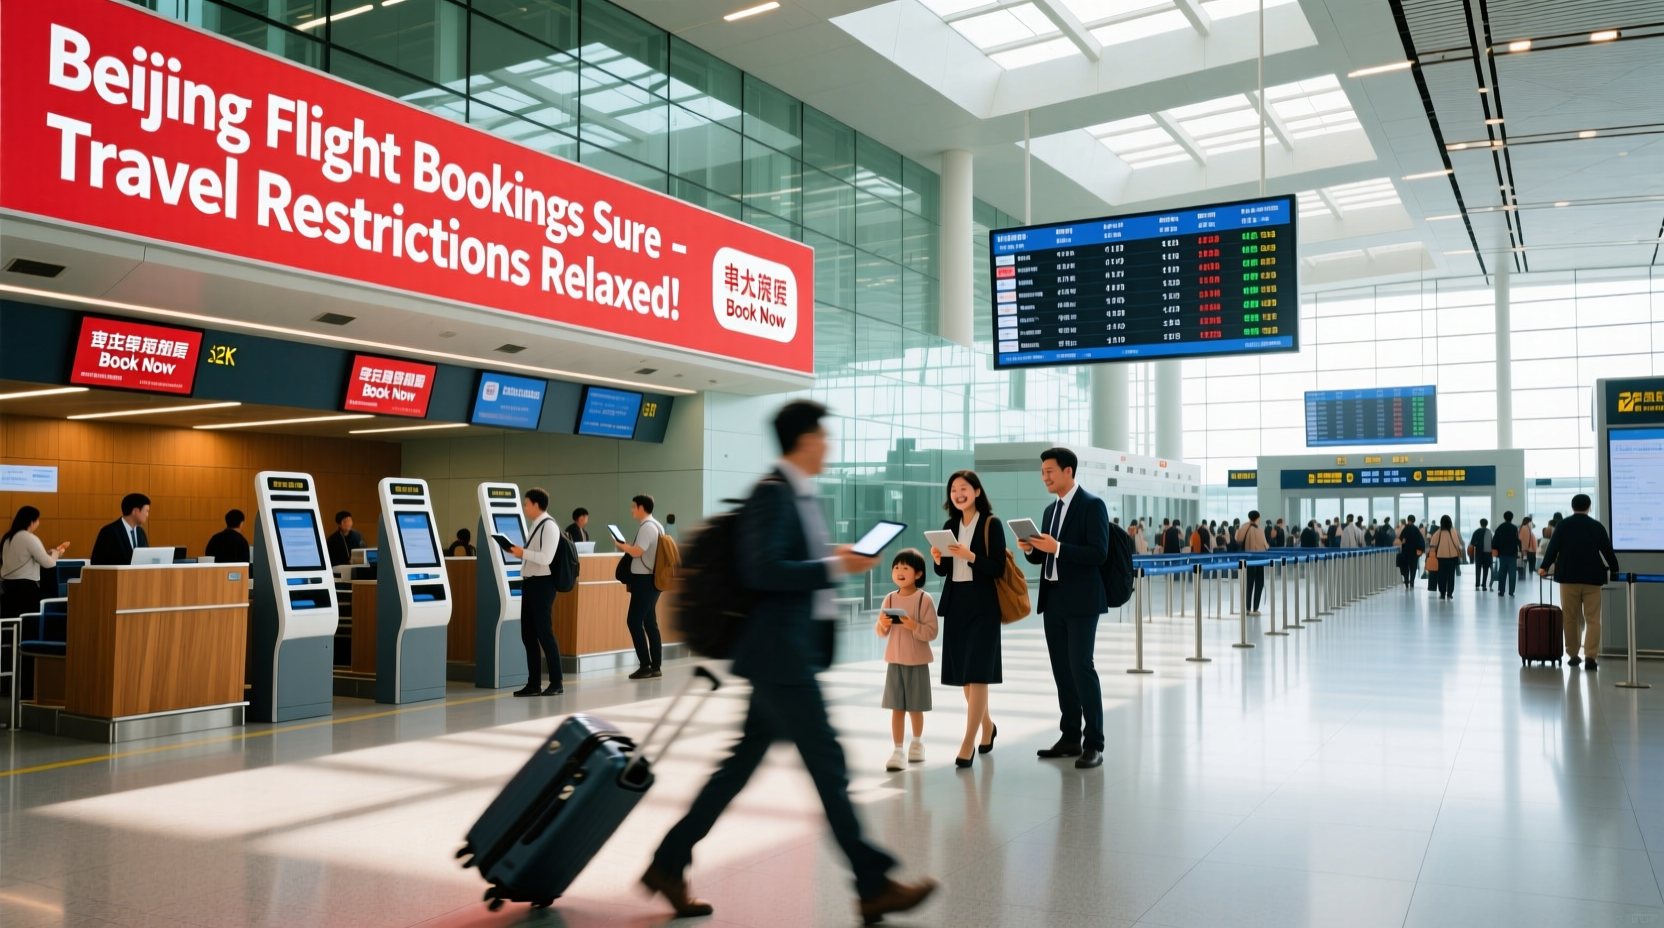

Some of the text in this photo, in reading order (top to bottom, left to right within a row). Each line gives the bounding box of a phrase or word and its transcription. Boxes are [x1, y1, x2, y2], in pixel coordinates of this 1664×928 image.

[49, 24, 252, 153] Beijing
[266, 94, 402, 185] Flight
[413, 140, 585, 243] Bookings
[591, 200, 662, 259] Sure
[47, 112, 680, 322] Travel Restrictions Relaxed!
[726, 298, 786, 329] Book Now
[99, 351, 140, 371] Book
[142, 357, 177, 376] Now
[362, 383, 391, 400] Book
